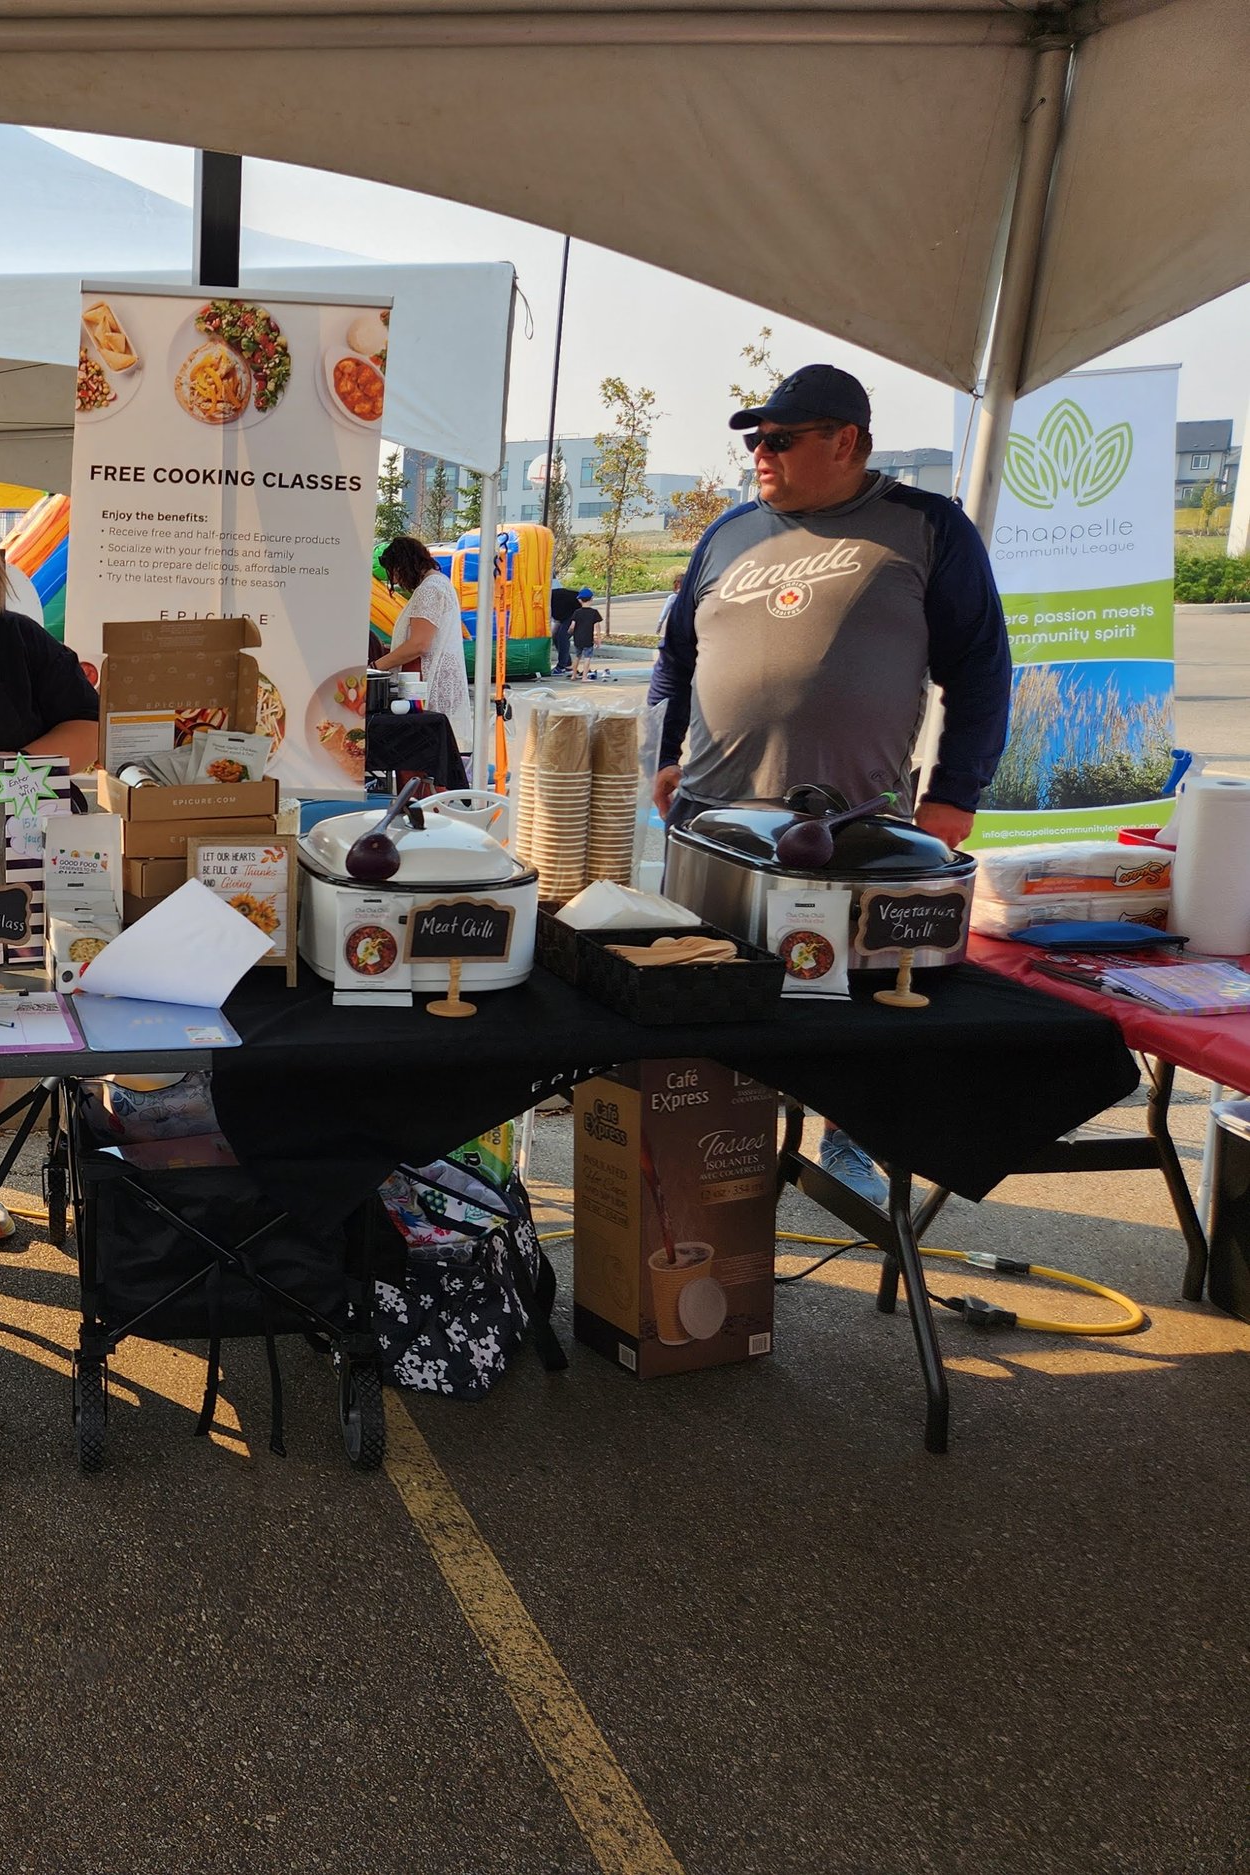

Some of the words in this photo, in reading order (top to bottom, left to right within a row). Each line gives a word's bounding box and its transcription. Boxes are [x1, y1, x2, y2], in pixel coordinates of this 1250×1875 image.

[90, 465, 145, 482] FREE
[153, 467, 255, 487] COOKING
[262, 471, 362, 492] CLASSES
[102, 510, 132, 522] Enjoy
[135, 511, 154, 521] the
[157, 512, 208, 523] benefits:
[109, 527, 149, 537] Receive
[151, 528, 172, 538] free
[174, 529, 194, 539] and
[196, 530, 251, 541] half-priced
[253, 532, 292, 543] Epicure
[294, 535, 341, 546] products
[995, 518, 1133, 544] Chappelle
[107, 543, 152, 554] Socialize
[154, 546, 176, 554] with
[178, 547, 202, 557] your
[204, 546, 239, 557] friends
[242, 549, 261, 558] and
[264, 549, 295, 561] family
[995, 544, 1078, 560] Community
[1082, 542, 1135, 555] League
[107, 558, 136, 568] Learn
[139, 560, 150, 568] to
[152, 561, 192, 571] prepare
[195, 561, 242, 573] delicious,
[244, 563, 297, 574] affordable
[299, 566, 330, 576] meals
[719, 538, 861, 600] Canada
[107, 572, 122, 583] Try
[124, 573, 141, 582] the
[144, 573, 173, 584] latest
[175, 575, 215, 585] flavours
[218, 576, 228, 586] of
[231, 577, 247, 587] the
[250, 579, 286, 588] season
[1004, 613, 1029, 626] ere
[1034, 607, 1096, 627] passion
[1102, 603, 1155, 618] meets
[1007, 627, 1090, 645] ommunity
[1094, 624, 1136, 642] spirit
[8, 775, 29, 788] Enter
[172, 796, 237, 806] EPICURE.COM
[59, 859, 78, 867] GOOD
[202, 852, 215, 861] LET
[217, 852, 230, 861] OUR
[231, 852, 256, 861] HEARTS
[203, 866, 210, 875] BE
[212, 866, 227, 875] FULL
[230, 866, 238, 875] OF
[243, 864, 277, 877] Thanks
[203, 878, 216, 888] AND
[220, 876, 252, 892] Giving
[879, 900, 956, 926] Vegetarian
[420, 916, 459, 935] Meat
[461, 918, 494, 939] Chilli
[666, 1067, 699, 1090] Café
[651, 1090, 710, 1113] EXpress
[594, 1098, 619, 1125] Café
[584, 1112, 628, 1147] EXpress
[697, 1129, 767, 1162] Tasses
[706, 1154, 759, 1171] ISOLANTES
